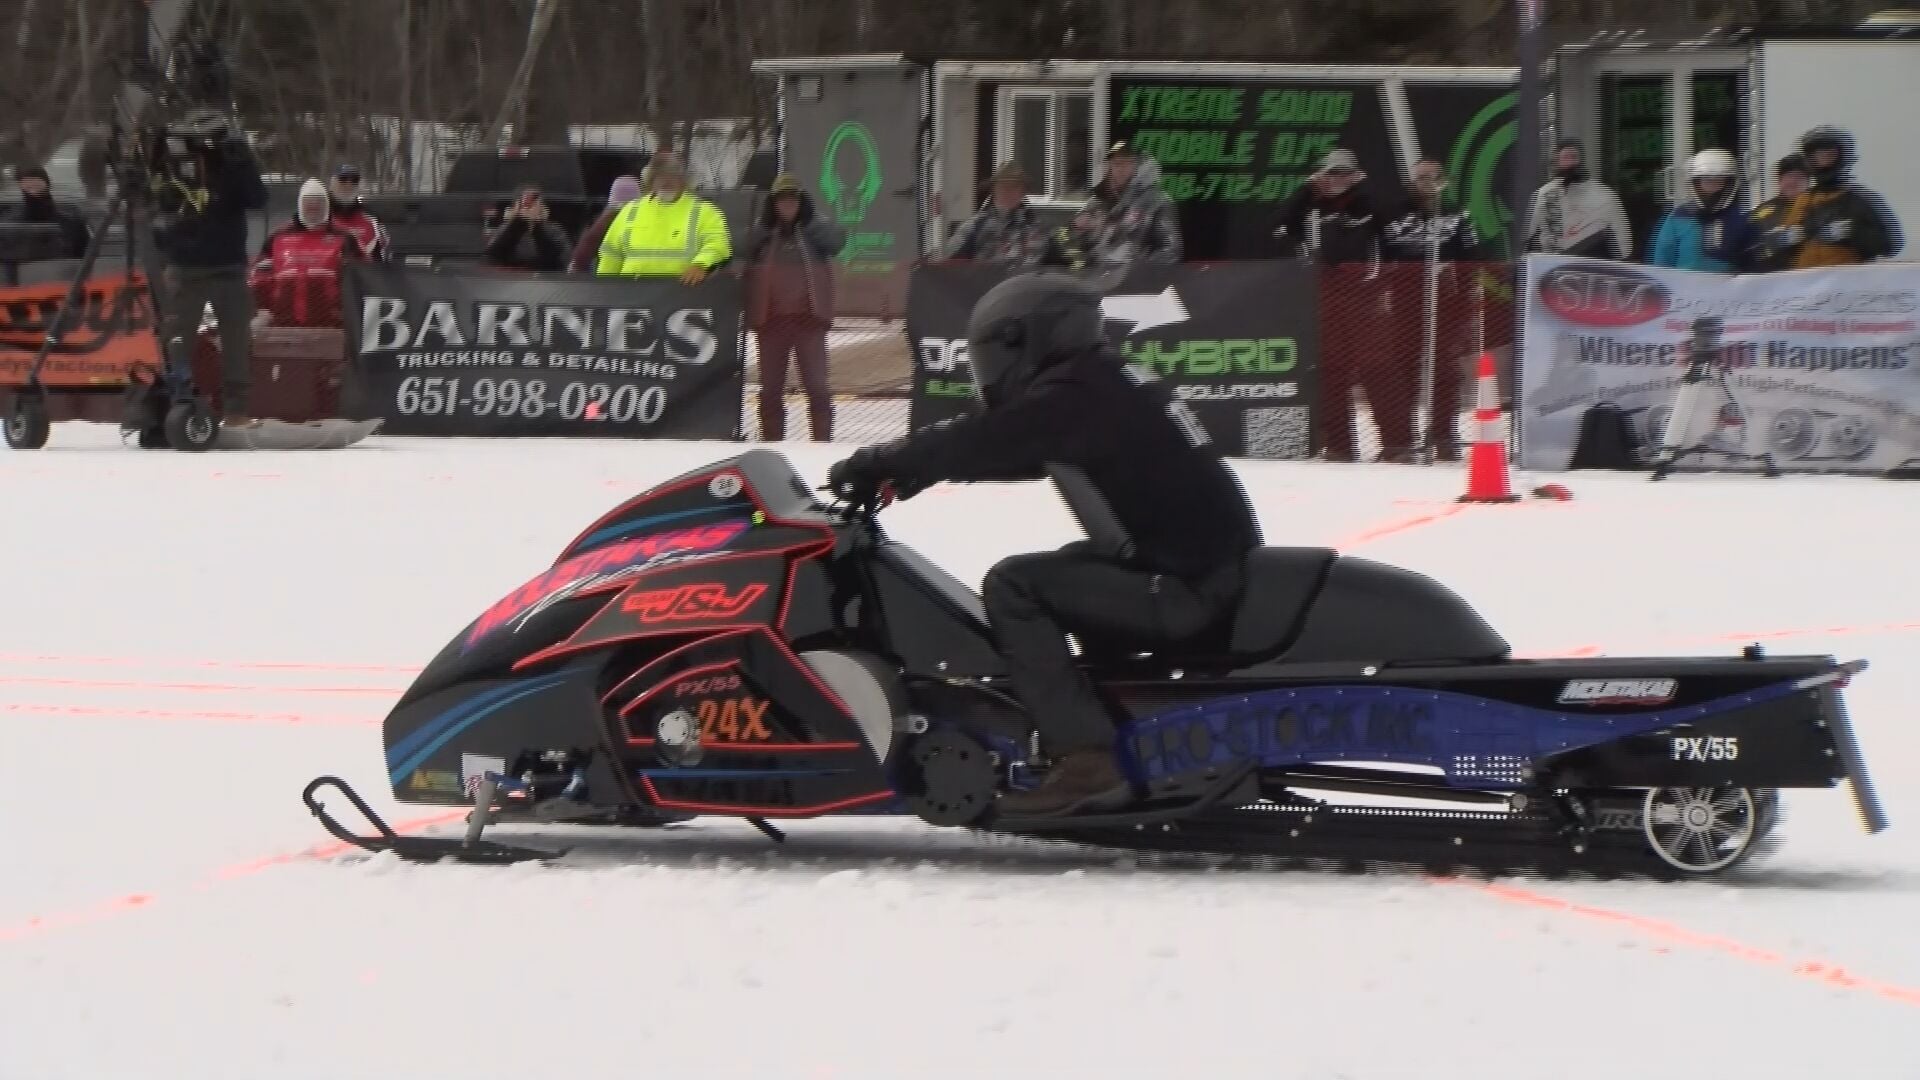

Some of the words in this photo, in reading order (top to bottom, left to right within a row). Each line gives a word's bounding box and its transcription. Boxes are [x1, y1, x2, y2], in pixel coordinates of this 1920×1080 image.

[1119, 86, 1247, 123] XTREME
[1255, 88, 1353, 126] SOUND
[1133, 130, 1259, 166] MOBILE
[360, 296, 718, 365] BARNES
[396, 352, 516, 368] TRUCKING
[522, 353, 541, 368] &
[548, 353, 678, 380] DETAILING
[396, 376, 668, 424] 651-998-0200
[1172, 383, 1299, 401] SOLUTIONS
[674, 674, 742, 698] PX/55
[1562, 679, 1674, 700] MOUSTAKAS
[697, 695, 773, 743] 24X
[1673, 735, 1739, 763] PX/55
